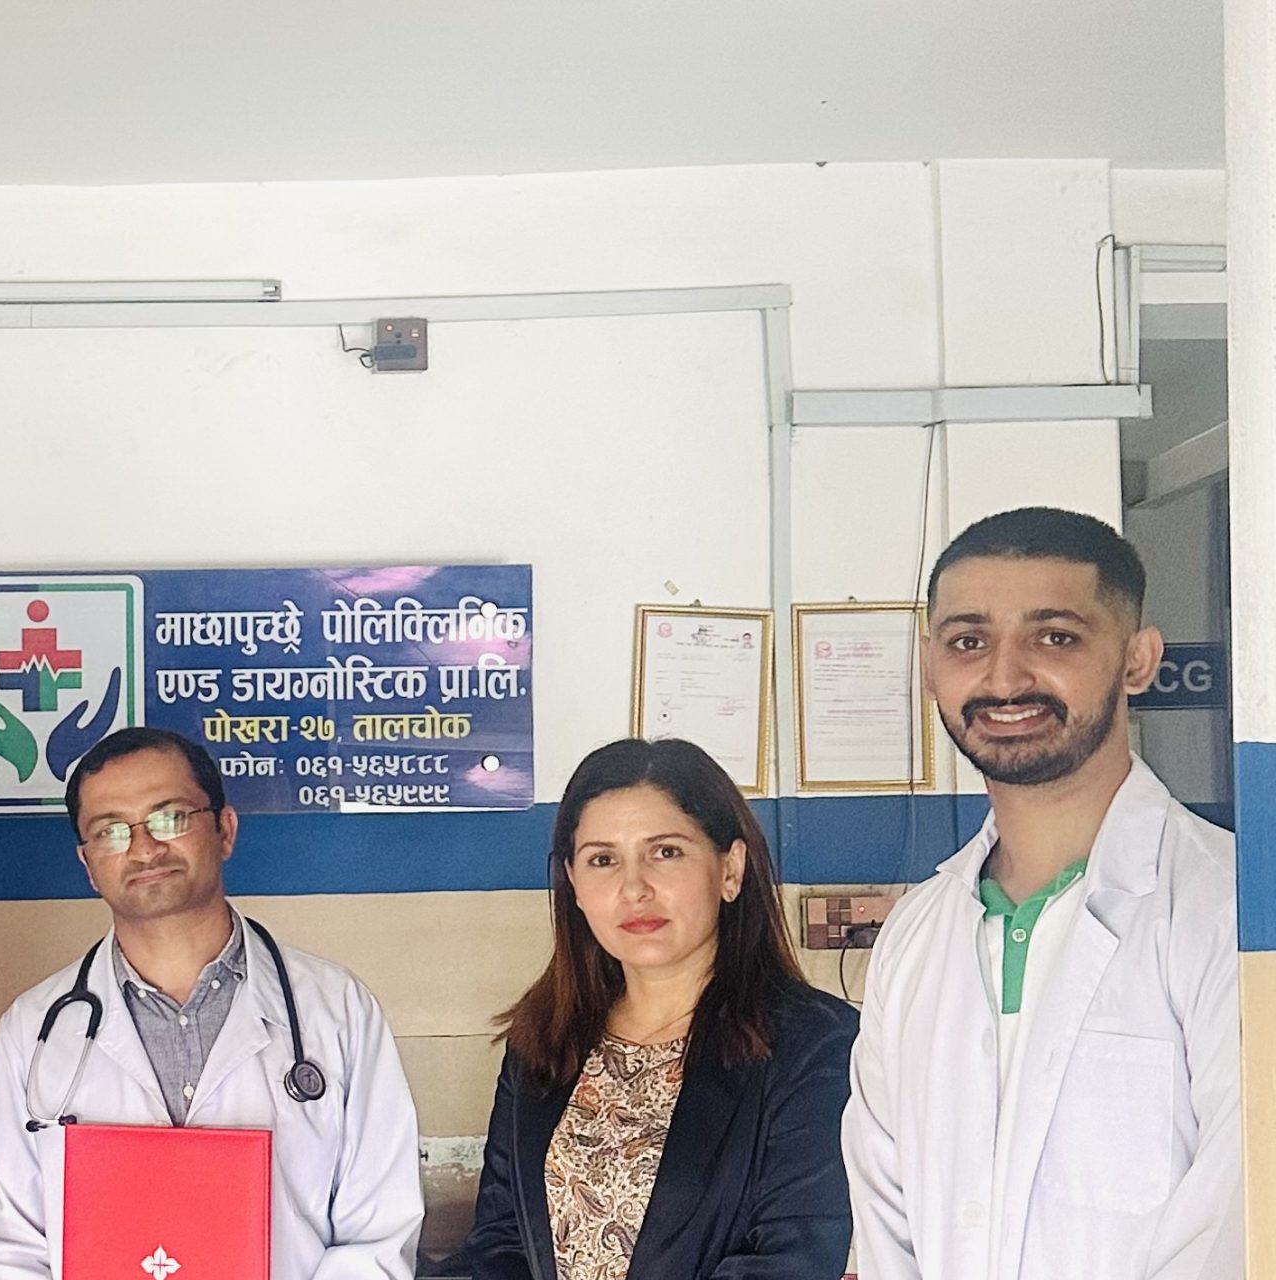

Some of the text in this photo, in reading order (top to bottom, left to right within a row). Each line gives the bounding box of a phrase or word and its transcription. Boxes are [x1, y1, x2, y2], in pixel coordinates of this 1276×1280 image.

[156, 653, 527, 704] एण्ड डायग्नोस्टिक प्रा.लि.
[1145, 660, 1214, 693] CG
[353, 705, 472, 742] तालचोक
[296, 754, 449, 778] ०६१-५६५८८८
